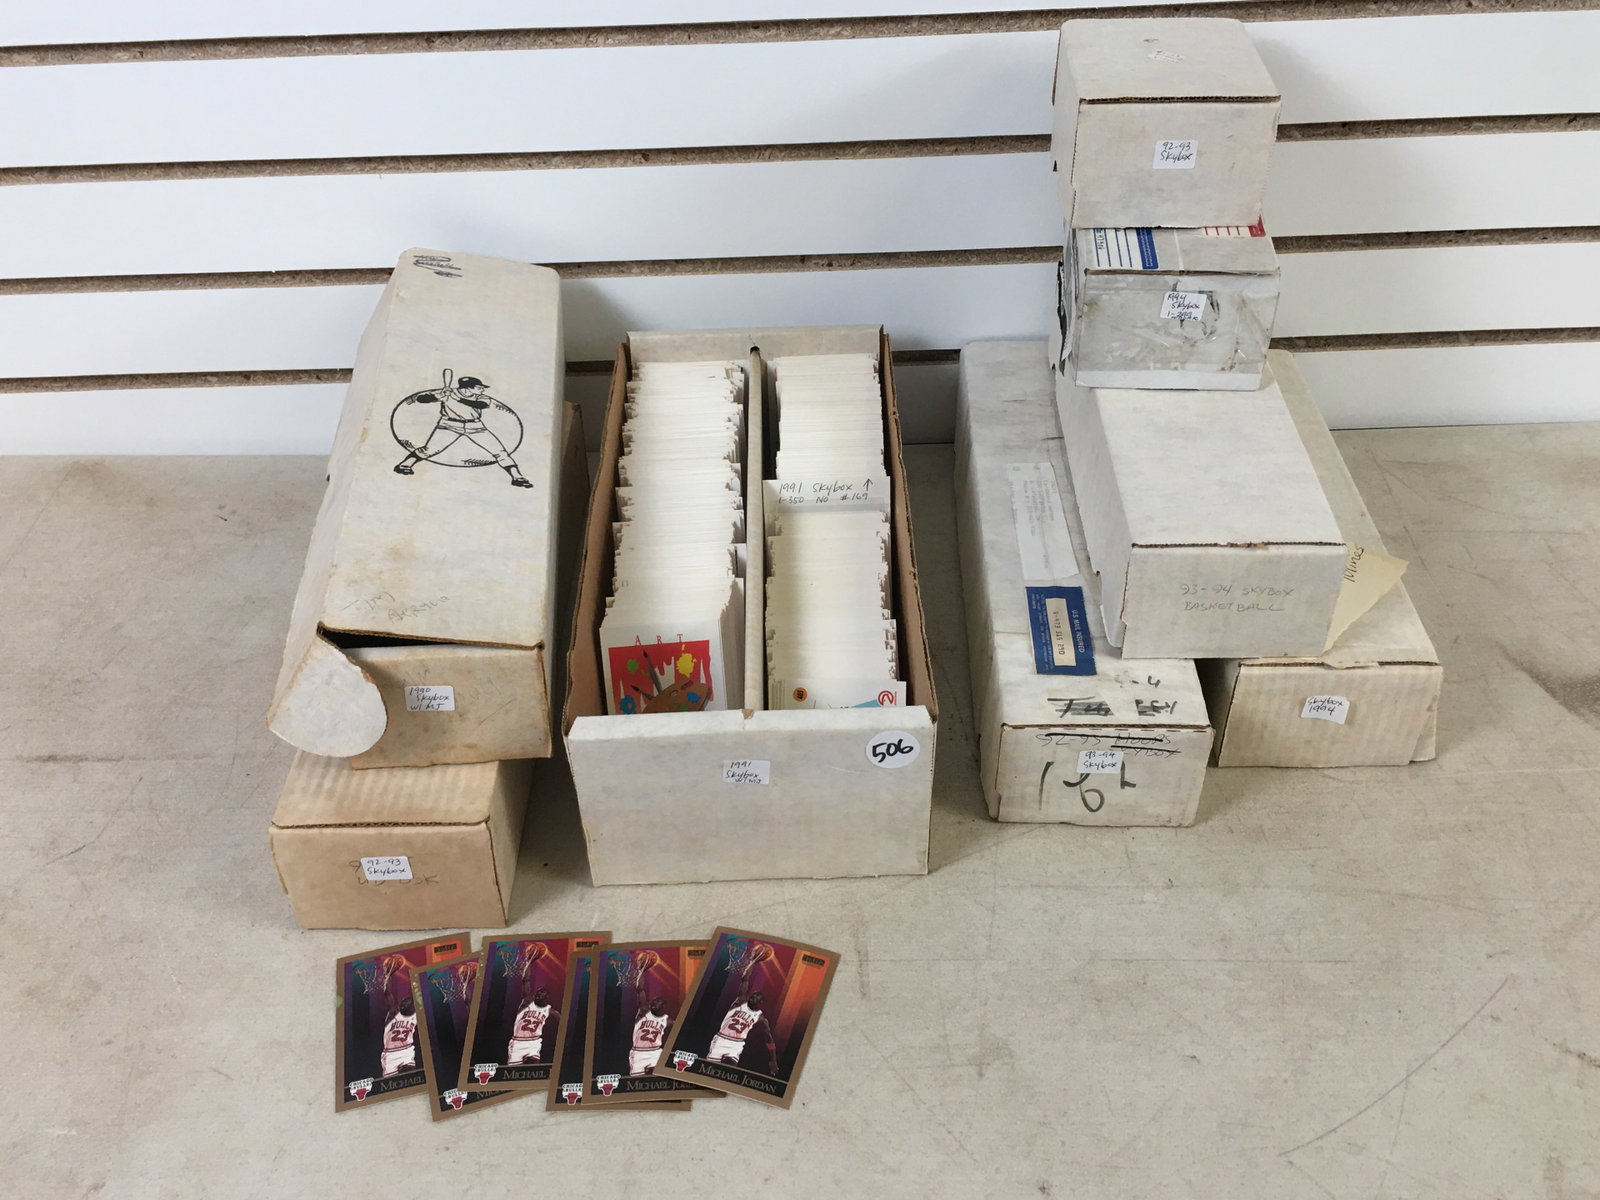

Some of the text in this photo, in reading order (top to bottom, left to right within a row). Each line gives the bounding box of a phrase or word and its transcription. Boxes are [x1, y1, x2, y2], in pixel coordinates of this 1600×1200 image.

[1162, 141, 1191, 151] 92-93
[1160, 149, 1193, 163] Skybox
[779, 480, 853, 496] 1991 Skybox
[779, 496, 805, 504] 1-350
[1241, 585, 1295, 597] SKYBOX
[410, 686, 431, 695] 1990
[416, 693, 450, 704] Skybox
[1308, 704, 1336, 716] 1994
[872, 738, 914, 763] 506
[730, 761, 752, 769] 1991
[1083, 760, 1118, 771] Skybox
[367, 859, 402, 867] 92-93
[366, 866, 407, 876] Skybox
[521, 1019, 542, 1032] 23
[728, 1018, 750, 1034] 23
[391, 1029, 411, 1042] 23
[640, 1029, 661, 1042] 23
[503, 1069, 546, 1080] MICHAEL
[699, 1063, 777, 1093] MICHAEL JORDAN
[381, 1075, 425, 1092] MICHAEL
[626, 1080, 670, 1091] MICHAEL
